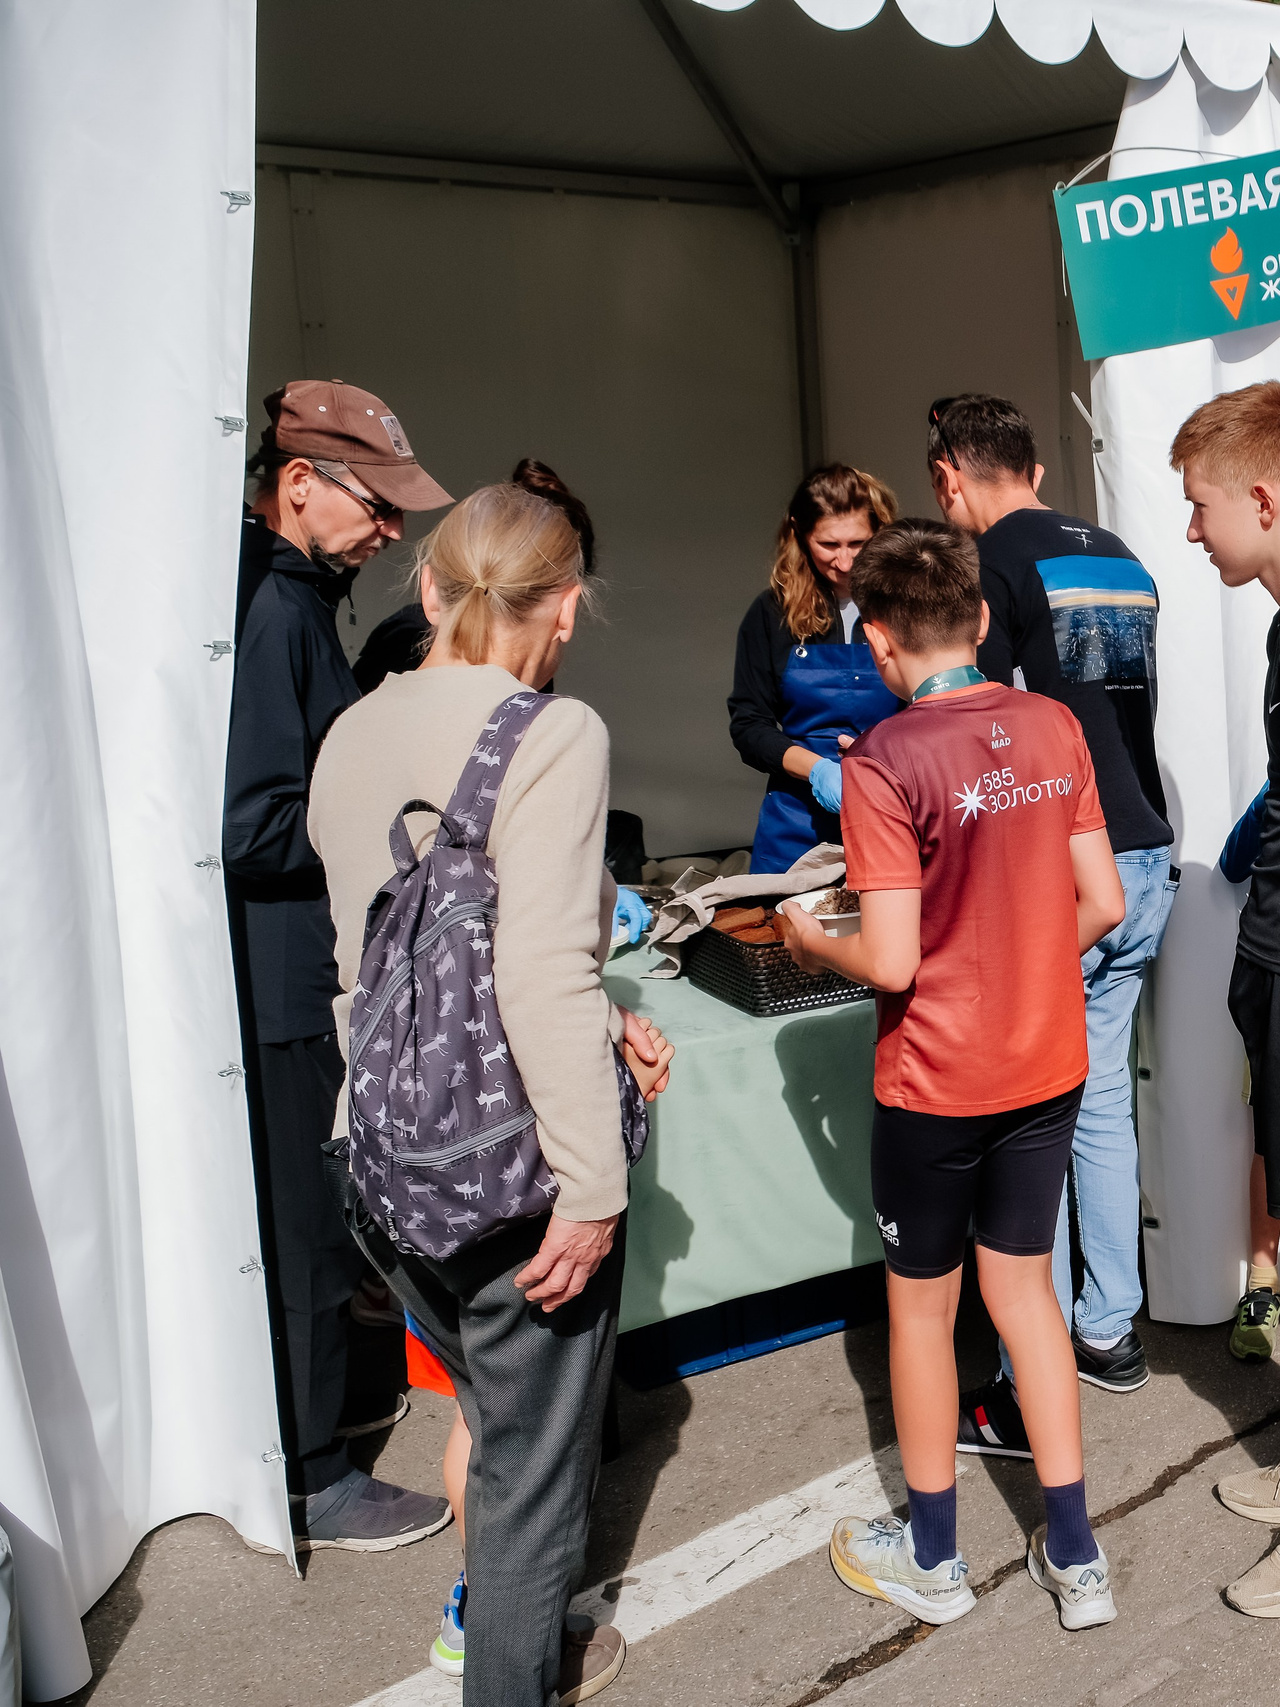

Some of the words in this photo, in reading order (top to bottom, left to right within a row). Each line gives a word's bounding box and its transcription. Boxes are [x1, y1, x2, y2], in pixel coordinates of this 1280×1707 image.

[991, 737, 1011, 749] MAD
[982, 767, 1015, 792] 585
[988, 773, 1073, 814] ЗОЛОТОЙ
